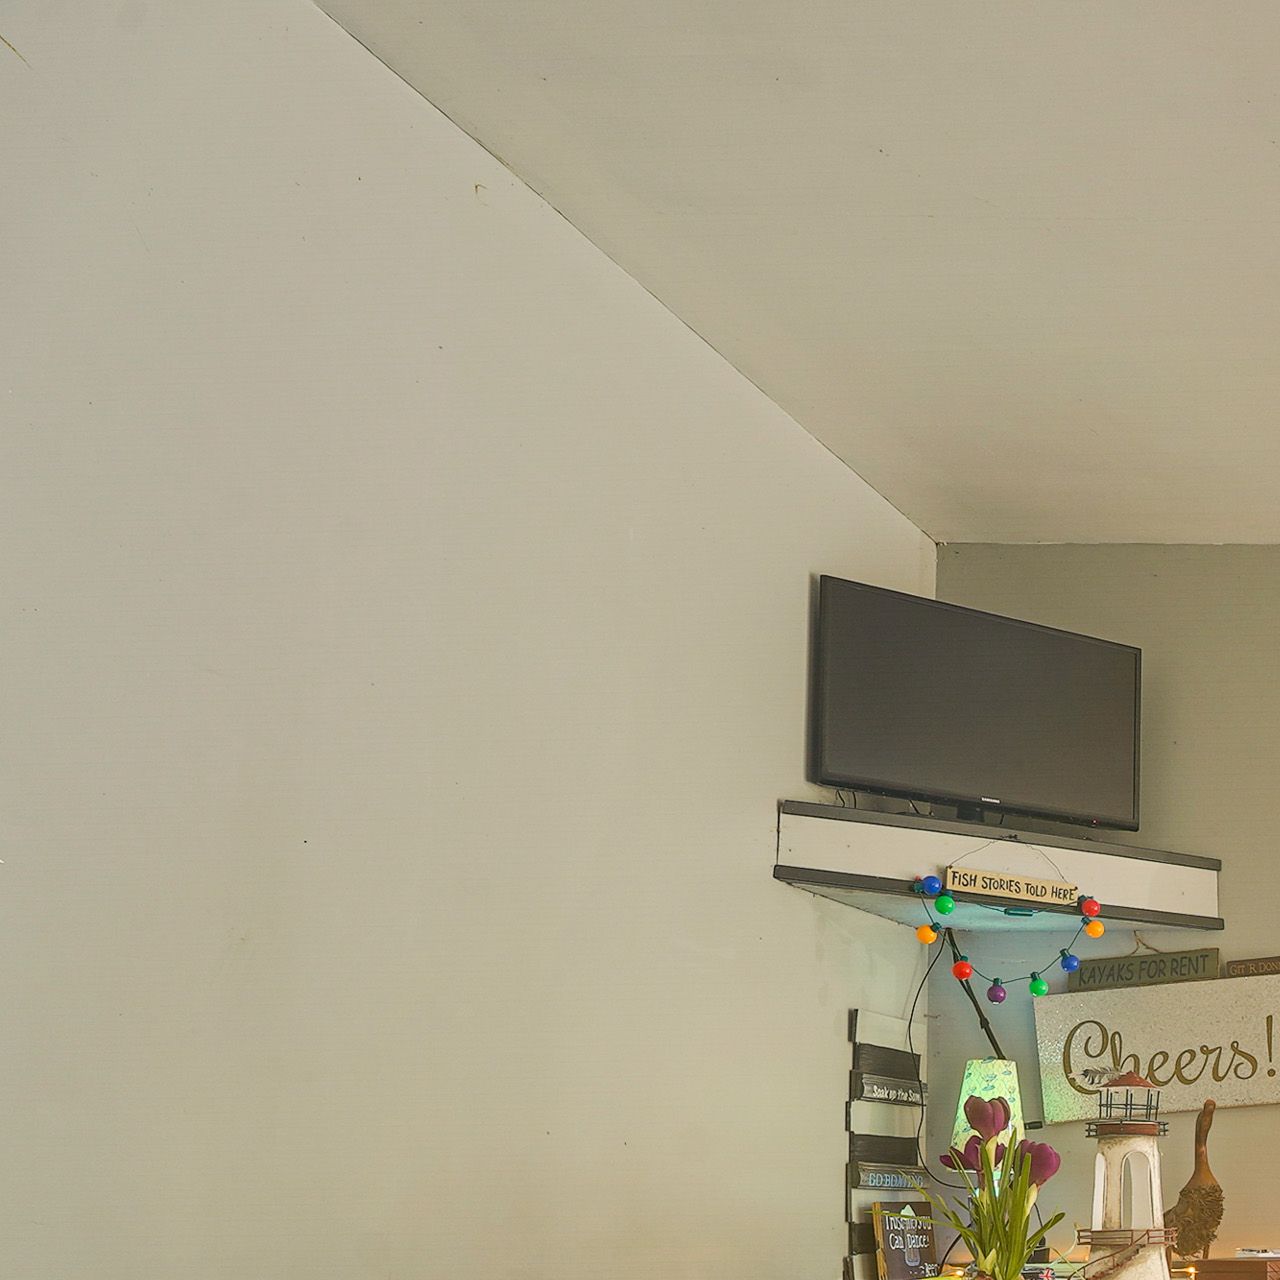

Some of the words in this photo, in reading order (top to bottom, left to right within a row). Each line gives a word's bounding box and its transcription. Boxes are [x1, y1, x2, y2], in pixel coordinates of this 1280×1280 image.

[951, 870, 978, 888] FISH
[981, 876, 1022, 894] STORIES
[1024, 882, 1047, 898] TOLD
[1051, 886, 1076, 901] HERE
[1078, 962, 1134, 987] KAYAKS
[1138, 960, 1167, 980] FOR
[1170, 954, 1210, 976] RENT
[1229, 963, 1245, 976] GIT
[1062, 1014, 1276, 1095] Cheers!
[869, 1172, 883, 1187] GO
